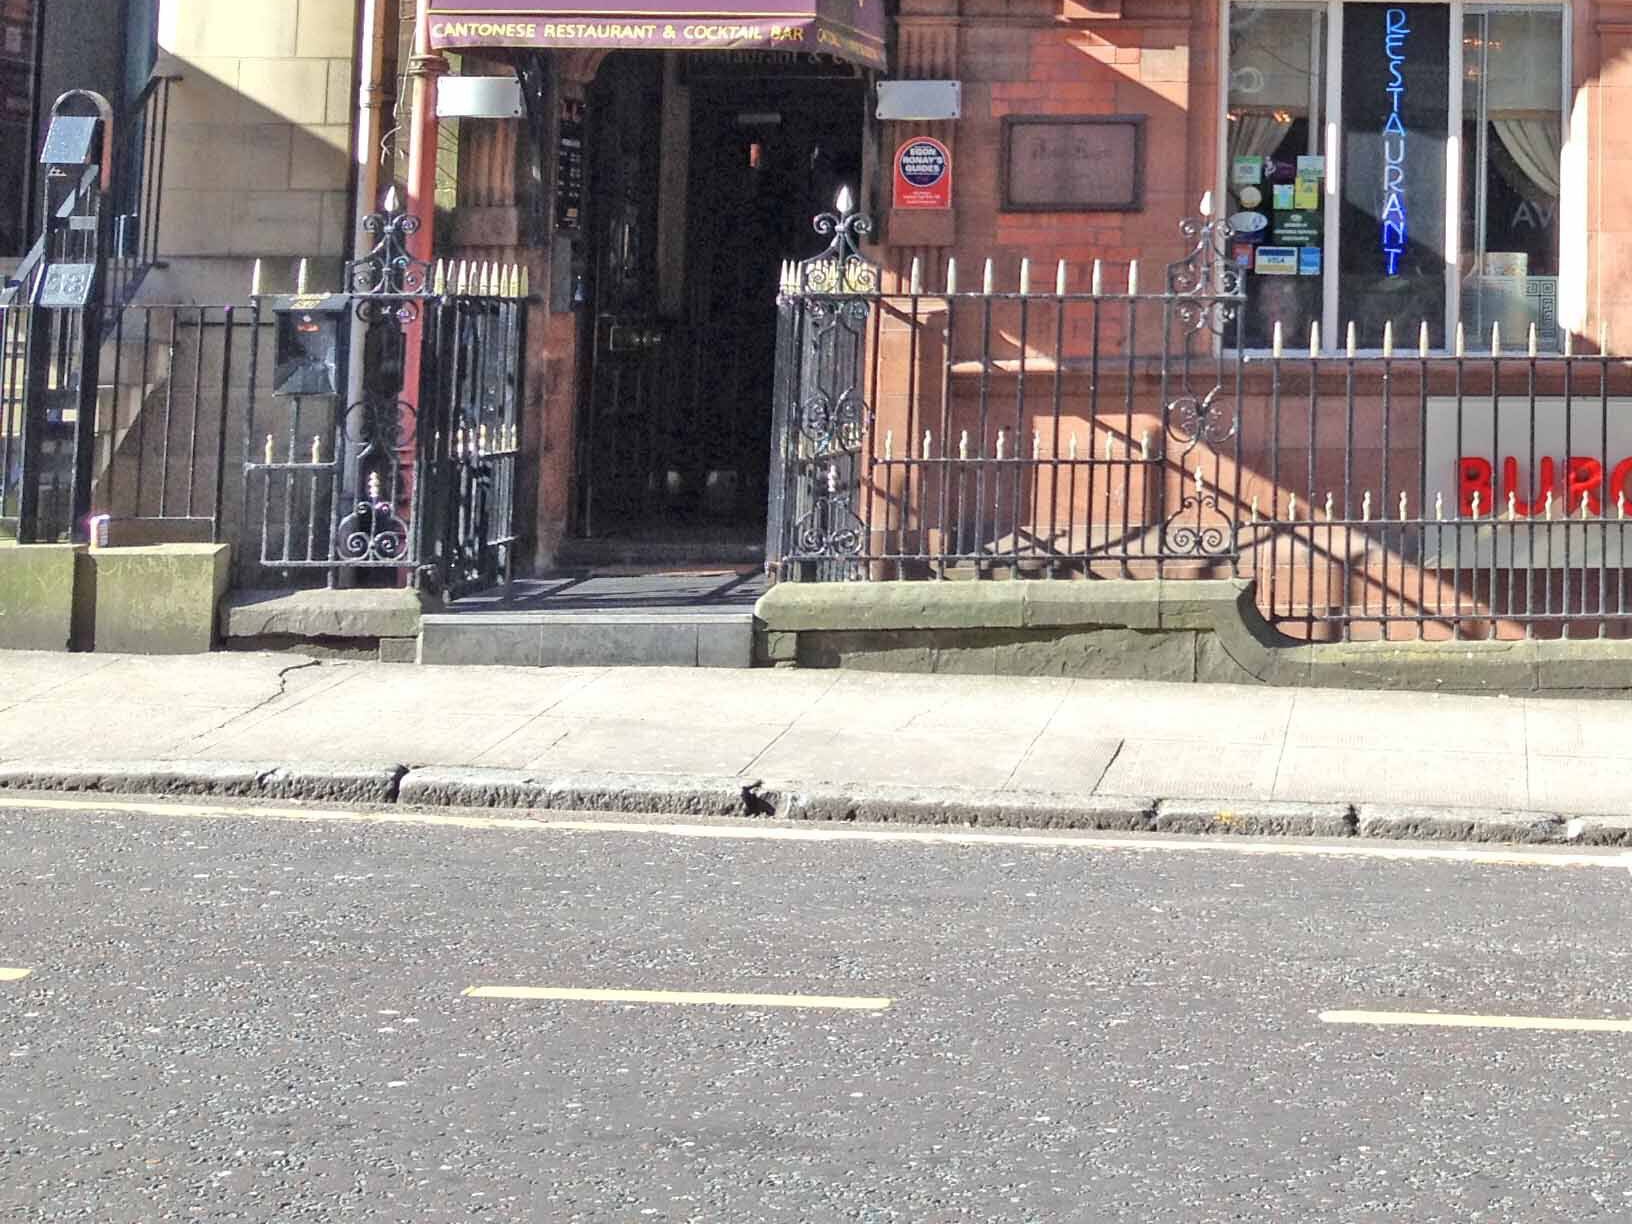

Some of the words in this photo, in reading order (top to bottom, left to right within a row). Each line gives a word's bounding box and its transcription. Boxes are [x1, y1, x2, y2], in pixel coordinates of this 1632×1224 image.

[432, 22, 536, 39] CANTONESE
[543, 23, 656, 40] RESTAURANT
[662, 24, 677, 40] &
[683, 24, 763, 41] COCKTAIL
[770, 26, 804, 42] BAR
[1381, 8, 1410, 276] RESTAURANT
